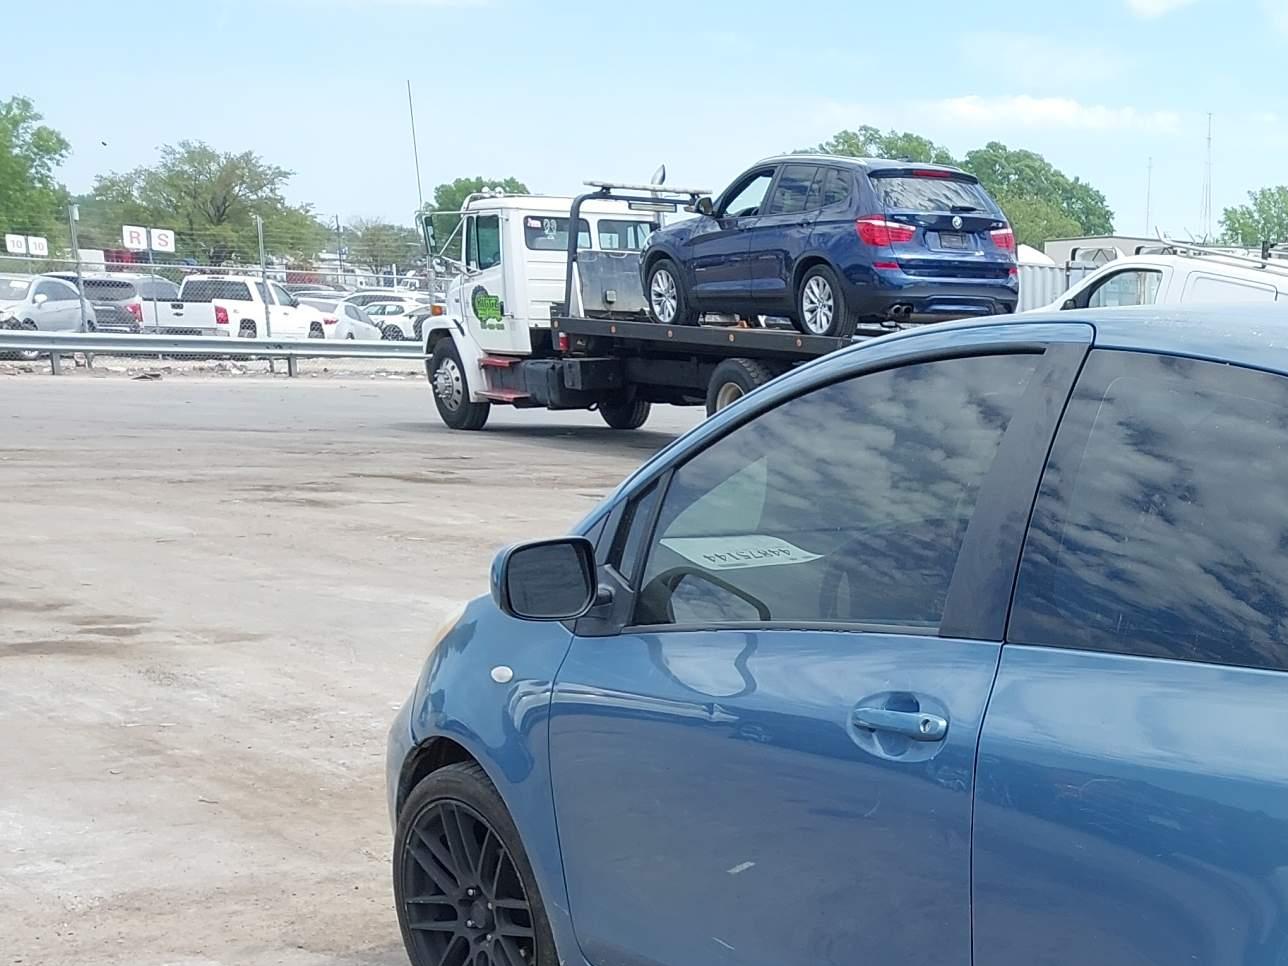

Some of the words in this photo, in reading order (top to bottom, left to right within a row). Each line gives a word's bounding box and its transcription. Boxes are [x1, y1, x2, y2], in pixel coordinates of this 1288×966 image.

[129, 230, 141, 244] R
[157, 233, 169, 247] S
[10, 239, 23, 249] 10
[32, 241, 45, 252] 10
